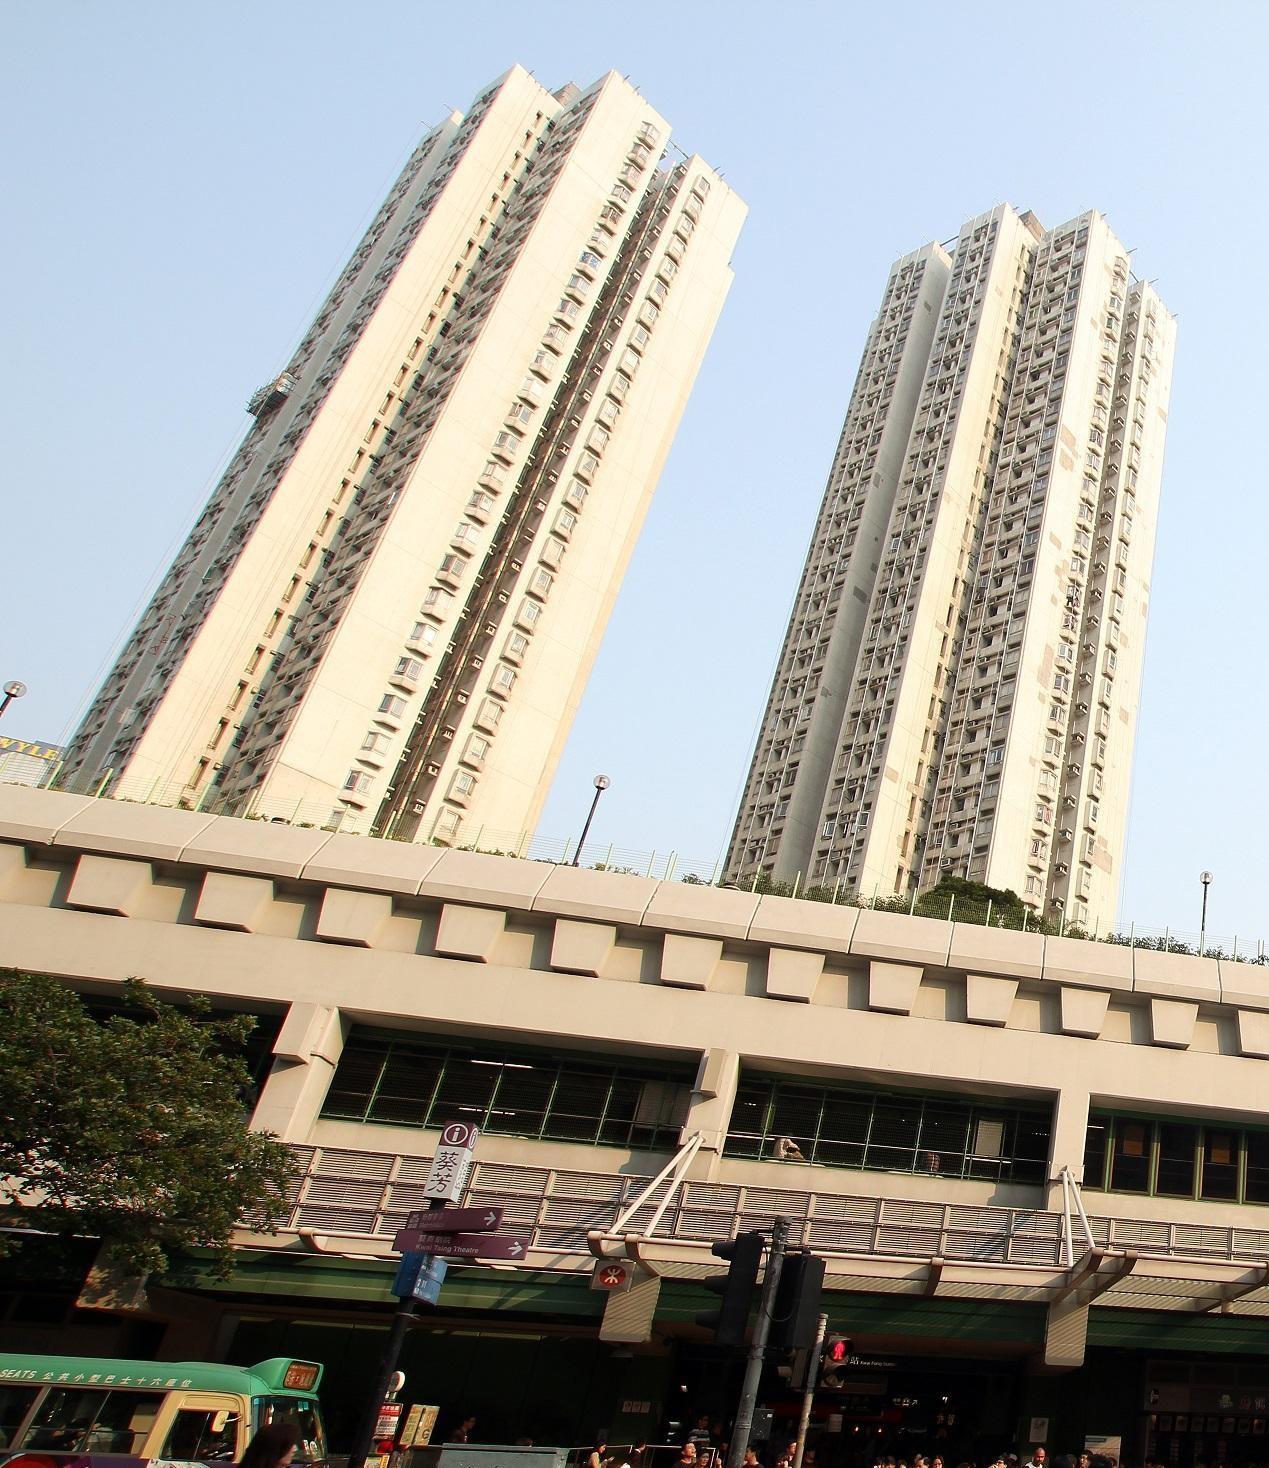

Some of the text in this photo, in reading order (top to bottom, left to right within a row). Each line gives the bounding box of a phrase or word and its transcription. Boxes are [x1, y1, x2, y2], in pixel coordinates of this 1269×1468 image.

[427, 1151, 459, 1193] 葵芳
[454, 1245, 480, 1254] Theatre
[0, 1369, 38, 1379] SEATS
